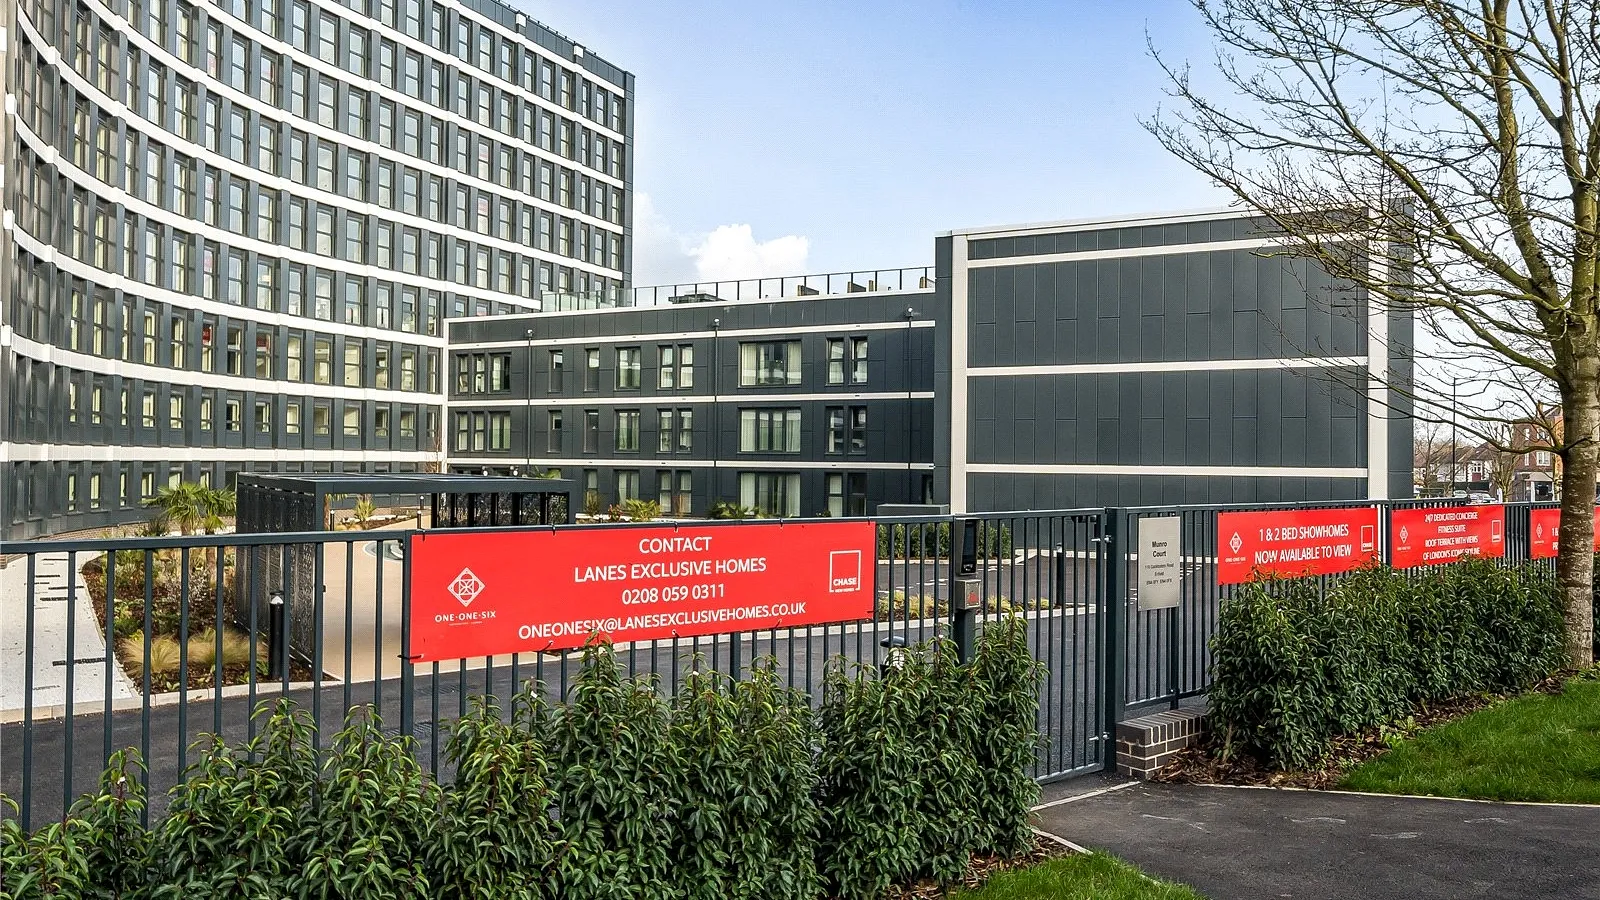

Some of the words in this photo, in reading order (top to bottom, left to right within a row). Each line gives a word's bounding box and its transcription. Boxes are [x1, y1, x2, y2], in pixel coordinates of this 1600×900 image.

[1434, 513, 1455, 521] DEDICATED
[1456, 512, 1478, 520] CONCIERGE
[1260, 529, 1264, 541] 1
[1266, 528, 1273, 541] &
[1275, 528, 1280, 541] 2
[1281, 527, 1298, 540] BED
[1299, 524, 1349, 539] SHOWHOMES
[1438, 525, 1454, 534] FITNESS
[1454, 524, 1466, 532] SUITE
[639, 537, 712, 554] CONTACT
[1425, 538, 1437, 547] ROOF
[1437, 537, 1455, 546] TERRACE
[1455, 536, 1466, 545] WITH
[1466, 535, 1478, 544] VIEWS
[1255, 550, 1278, 564] NOW
[1279, 546, 1320, 562] AVAILABLE
[1321, 545, 1332, 558] TO
[1333, 544, 1352, 557] VIEW
[1423, 552, 1430, 560] OF
[574, 565, 627, 583] LANES
[631, 560, 712, 580] EXCLUSIVE
[716, 557, 767, 574] HOMES
[833, 577, 857, 586] CHASE
[621, 588, 659, 605] 0208
[662, 585, 689, 602] 059
[692, 583, 725, 600] 0311
[518, 602, 807, 639] ONEONESIX@LANESEXCLUSIVEHOMES.CO.UK
